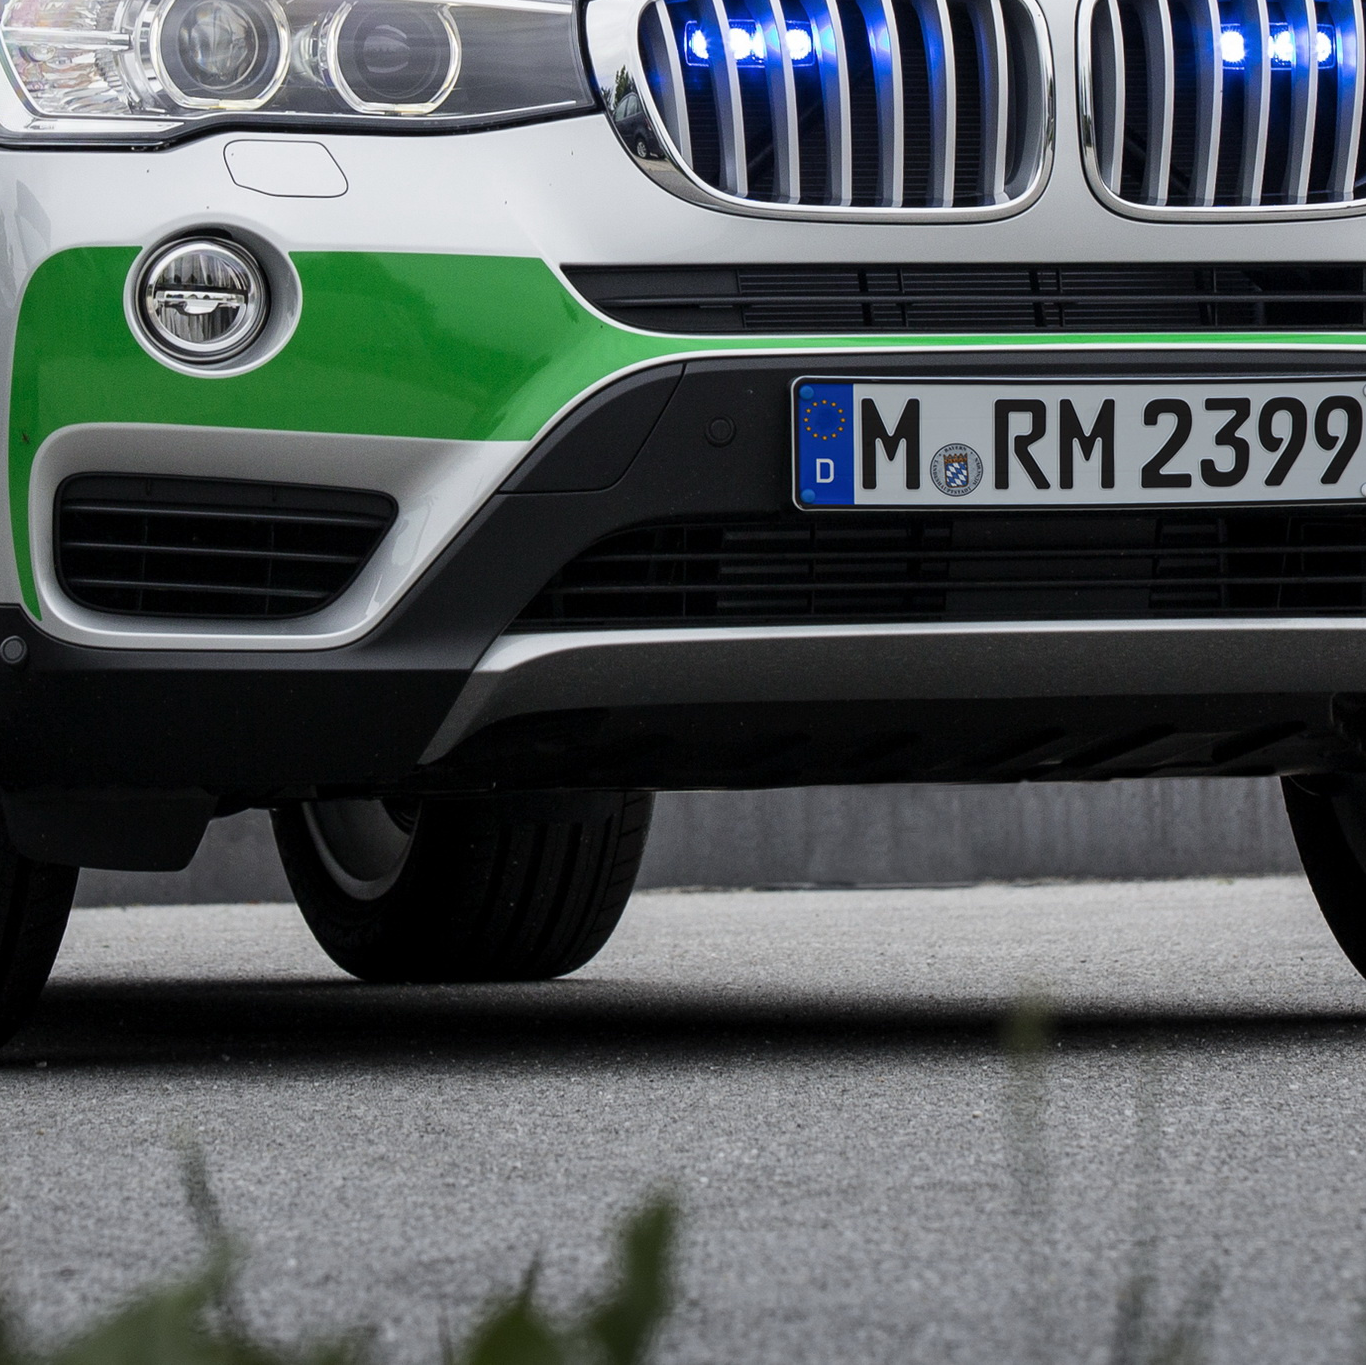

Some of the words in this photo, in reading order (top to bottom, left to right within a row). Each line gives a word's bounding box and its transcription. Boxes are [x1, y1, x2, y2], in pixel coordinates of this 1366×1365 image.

[815, 458, 835, 484] D
[861, 398, 920, 490] M
[994, 398, 1115, 490] RM
[1141, 395, 1363, 488] 2399
